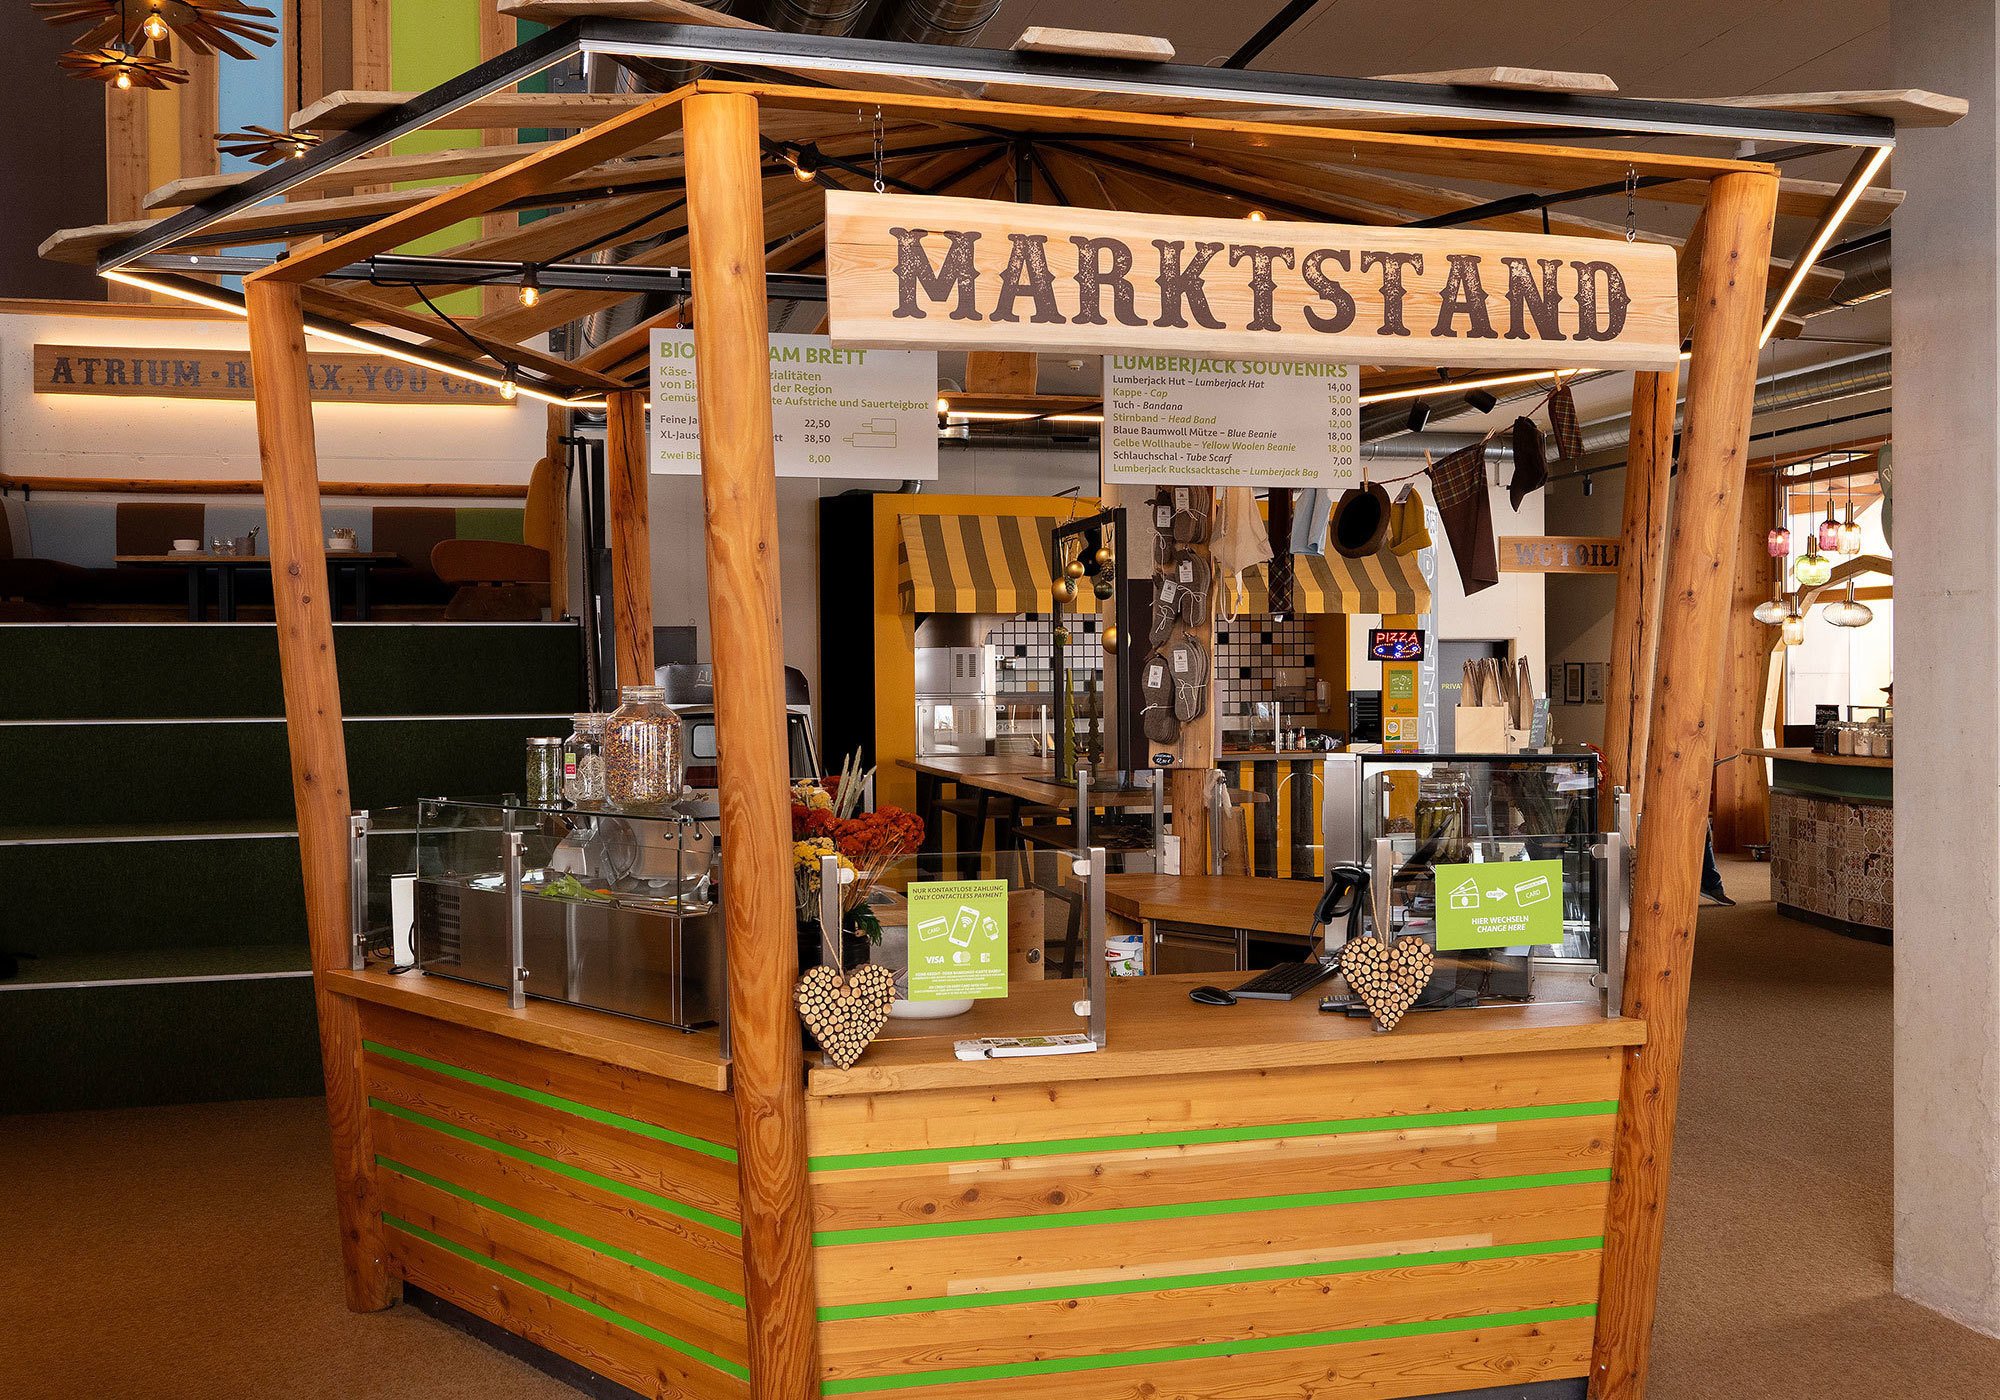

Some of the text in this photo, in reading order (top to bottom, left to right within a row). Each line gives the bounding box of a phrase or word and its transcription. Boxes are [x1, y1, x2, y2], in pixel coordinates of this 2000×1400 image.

[889, 227, 1632, 342] MARKTSTAND
[769, 346, 800, 362] AM
[806, 348, 867, 365] BRETT
[51, 356, 201, 387] ATRIUM
[361, 366, 427, 392] YOU
[660, 366, 821, 381] Käse- zialitäten
[1113, 355, 1348, 378] LUMBERJACK SOUVENIRS
[773, 383, 791, 393] der
[794, 384, 832, 396] Region
[1113, 375, 1166, 386] Lumberjack
[1168, 376, 1186, 386] Hut
[1195, 377, 1246, 389] Lumberjack
[1248, 379, 1264, 388] Hat
[1327, 383, 1352, 393] 14,00
[660, 393, 696, 402] Gemüs
[785, 397, 837, 407] Aufstriche
[840, 398, 858, 407] und
[862, 399, 928, 411] Sauerteigbrot
[1113, 388, 1142, 398] Kappe
[1150, 389, 1168, 399] Cap
[1328, 395, 1352, 405] 15,00
[1113, 400, 1134, 409] Tuch
[1143, 401, 1183, 411] Bandana
[1331, 408, 1352, 417] 8,00
[660, 415, 687, 424] Feine
[804, 419, 831, 430] 22,50
[1113, 413, 1158, 422] Stirnband
[1168, 414, 1191, 424] Head
[1193, 415, 1216, 424] Band
[1329, 420, 1352, 430] 12,00
[660, 431, 831, 444] XL-Jaus 38,50
[1113, 426, 1139, 435] Blaue
[1141, 427, 1187, 436] Baumwoll
[1190, 427, 1217, 437] Mütze
[1228, 429, 1246, 438] Blue
[1248, 430, 1277, 439] Beanie
[1327, 432, 1352, 442] 18,00
[1113, 438, 1140, 448] Gelbe
[1142, 440, 1192, 449] Wollhaube
[1202, 440, 1230, 450] Yellow
[1232, 441, 1265, 451] Woolen
[1267, 443, 1296, 452] Beanie
[1328, 444, 1352, 454] 18,00
[660, 451, 684, 459] Zwei
[809, 454, 831, 463] 8,00
[1113, 451, 1177, 461] Schlauchschal
[1187, 453, 1207, 462] Tube
[1209, 453, 1232, 464] Scarf
[1333, 457, 1352, 466] 7,00
[1113, 464, 1166, 475] Lumberjack
[1169, 466, 1240, 476] Rucksacktasche
[1250, 467, 1300, 477] Lumberjack
[1303, 469, 1318, 479] Bag
[1333, 469, 1352, 479] 7,00
[1514, 544, 1552, 566] WC
[1376, 632, 1418, 644] PIZZA
[1526, 890, 1540, 898] CARD
[1472, 917, 1488, 925] HIER
[1477, 924, 1507, 933] CHANGE
[925, 956, 944, 964] VISA
